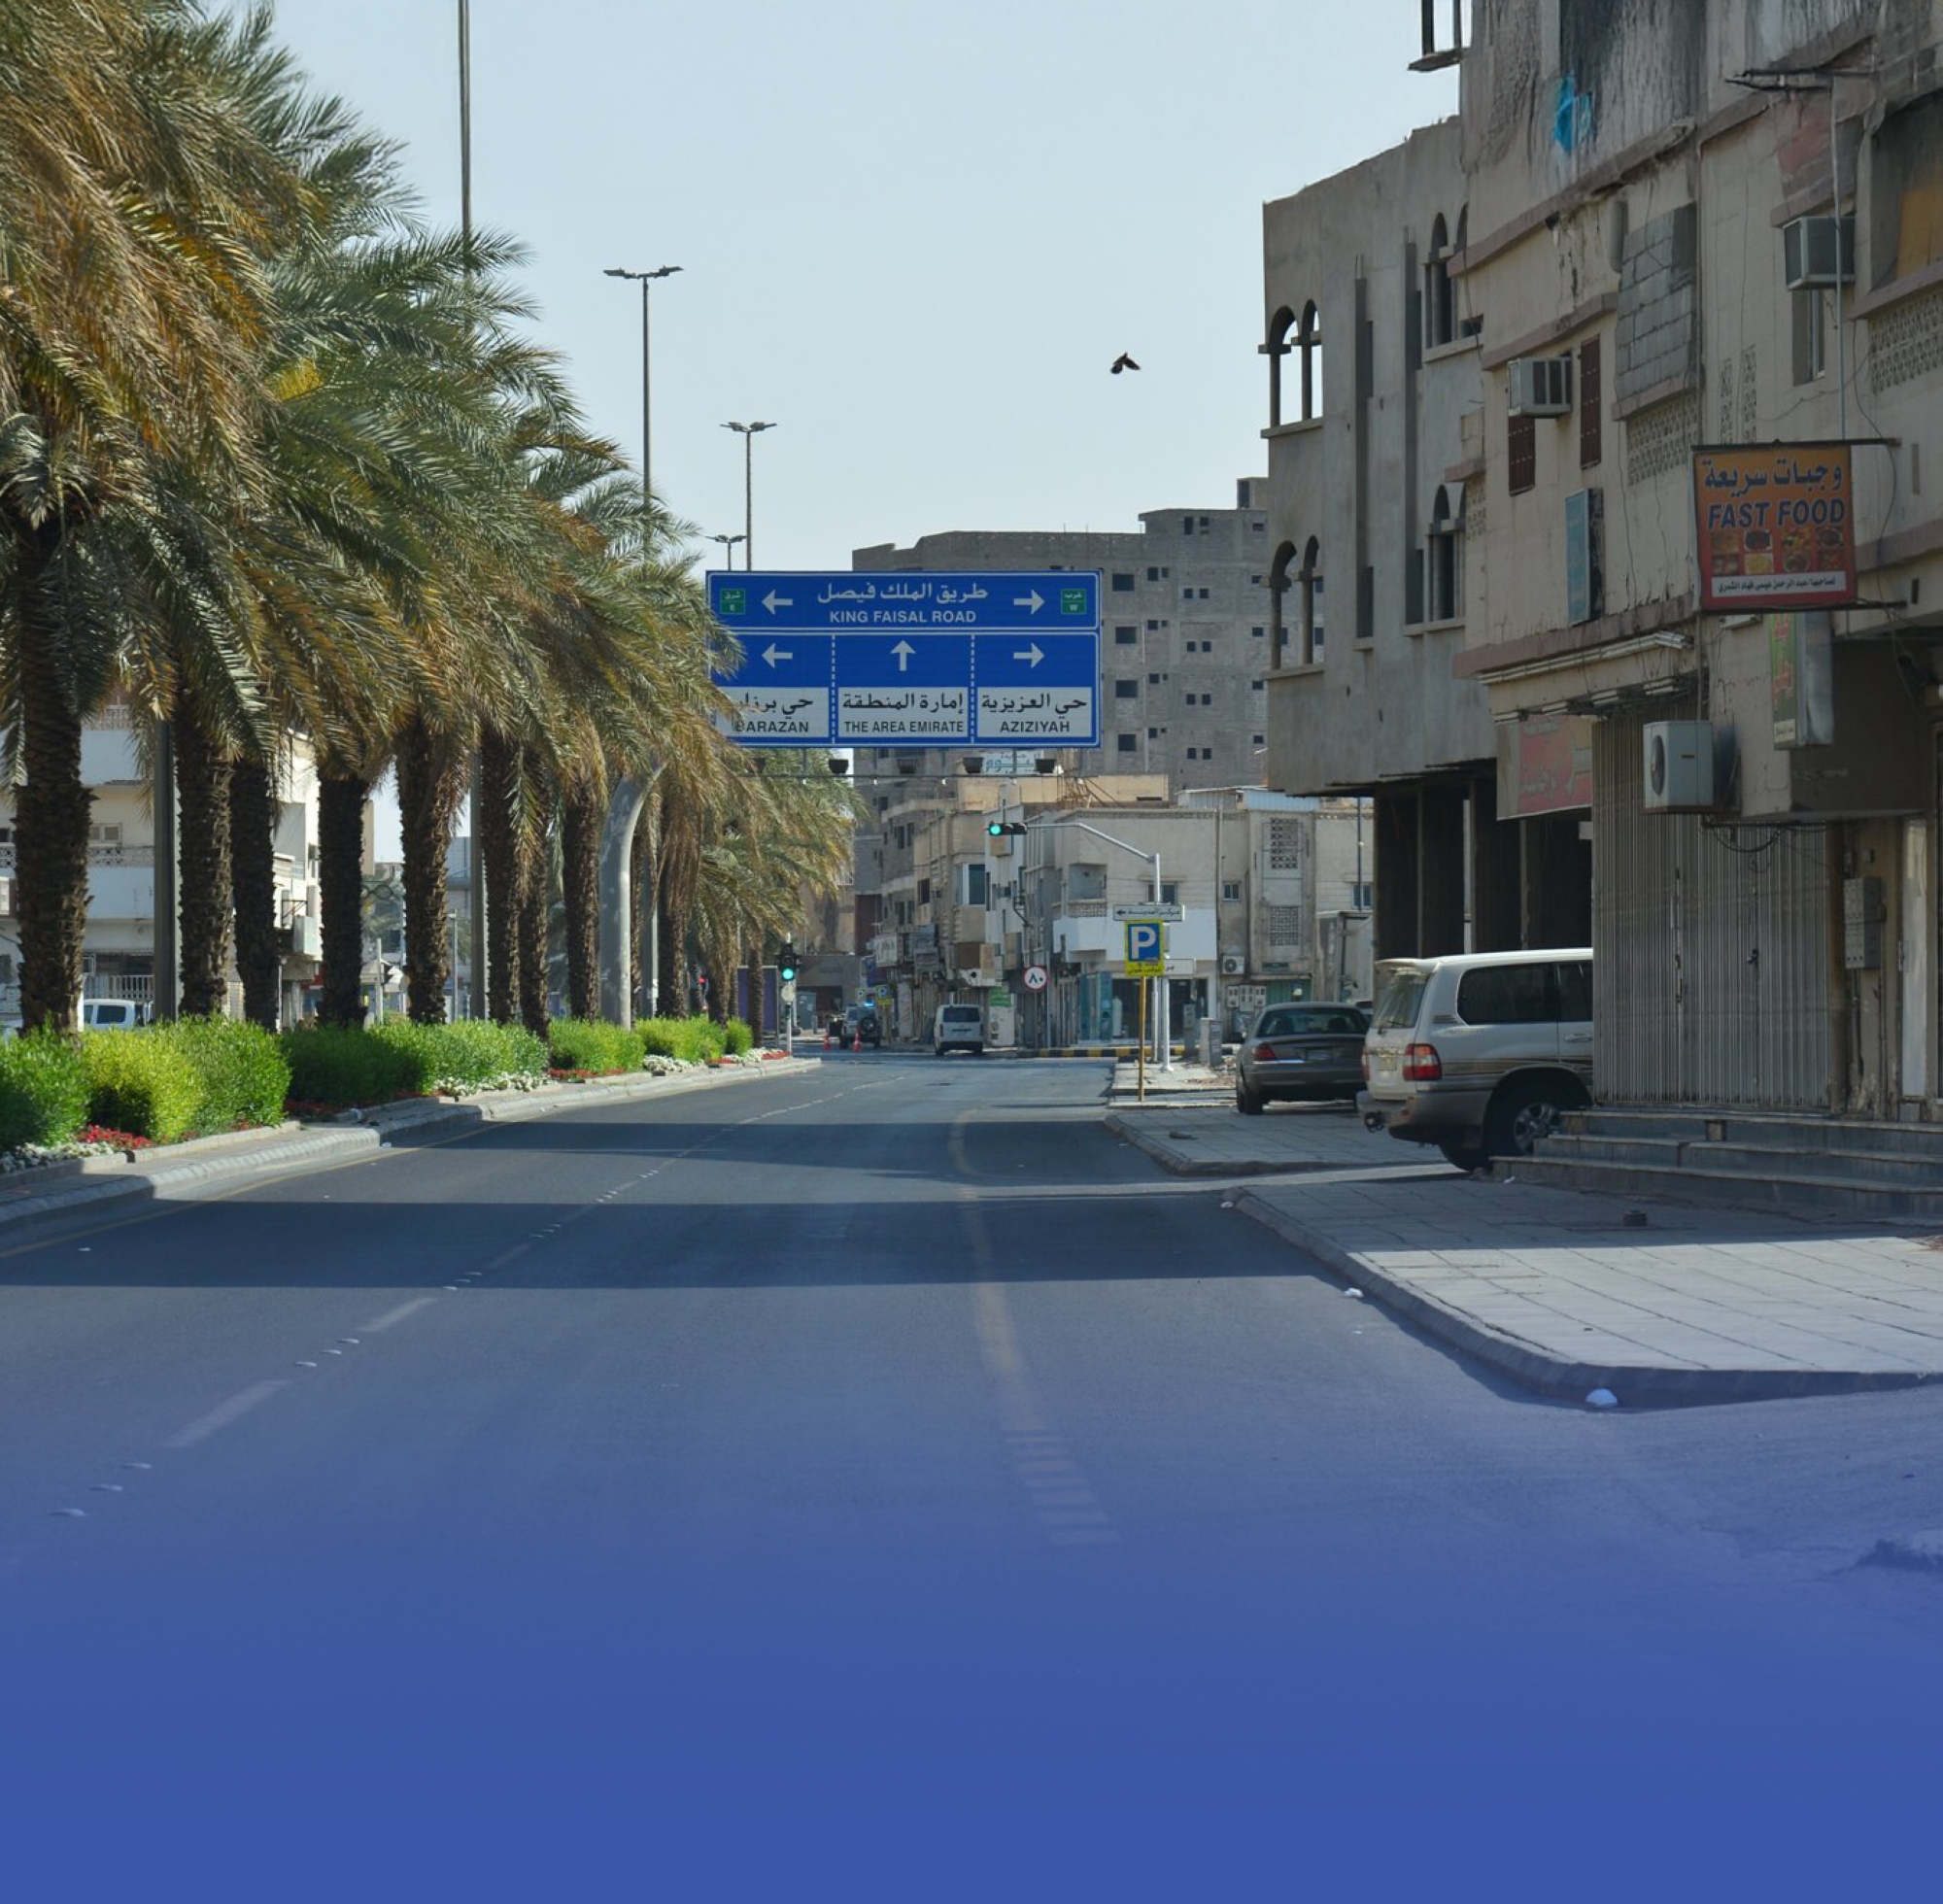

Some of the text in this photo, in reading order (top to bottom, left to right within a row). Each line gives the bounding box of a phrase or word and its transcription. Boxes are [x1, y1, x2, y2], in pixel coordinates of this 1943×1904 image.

[1702, 458, 1842, 497] وجبات سريعة
[1708, 497, 1846, 530] FAST FOOD
[817, 582, 989, 604] طريق الملك فيصل
[829, 610, 976, 623] KING FAISAL ROAD
[782, 697, 814, 720] حي
[842, 692, 964, 715] إمارة المنطقة
[981, 693, 1087, 720] حي العزيزية
[844, 721, 964, 732] THE AREA EMIRATE
[1000, 721, 1071, 732] AZIZIYAH
[1131, 926, 1156, 960] P
